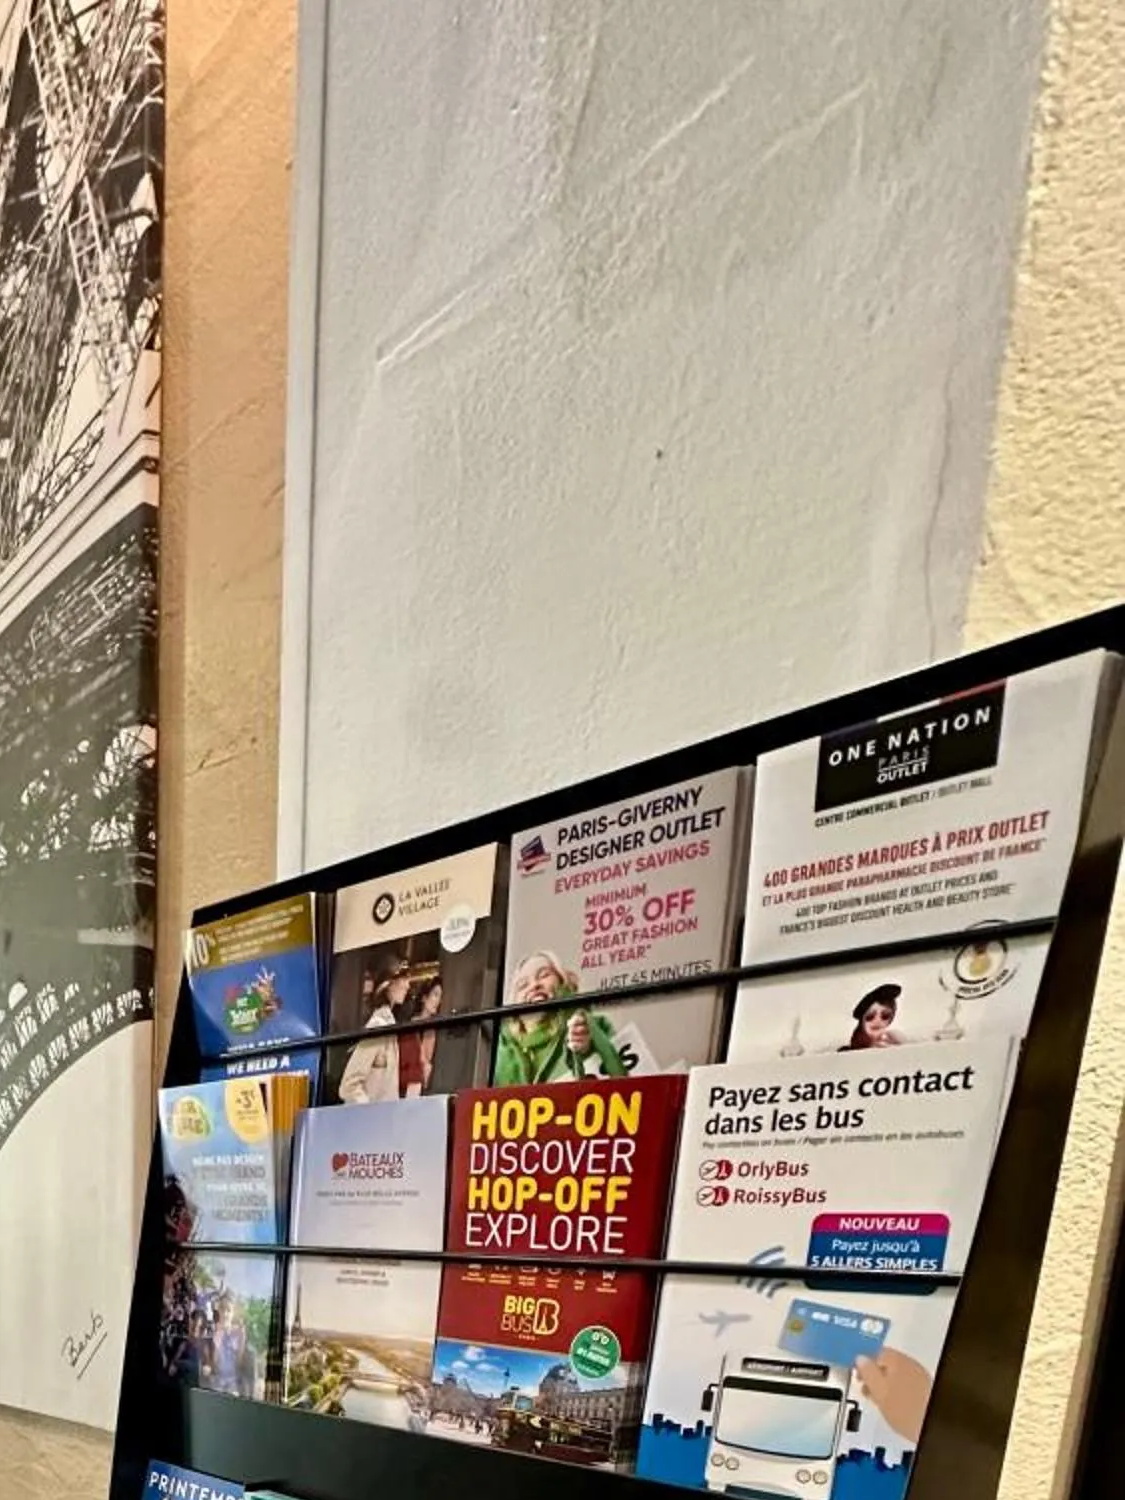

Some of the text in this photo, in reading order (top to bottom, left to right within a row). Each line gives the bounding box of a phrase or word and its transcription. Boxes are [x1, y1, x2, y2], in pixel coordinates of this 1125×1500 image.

[829, 706, 991, 766] ONE NATION
[878, 745, 930, 767] PARIS
[877, 762, 927, 784] OUTLET
[557, 786, 703, 846] PARIS-GIVERNY
[556, 807, 725, 871] DESIGNER OUTLET
[763, 810, 1050, 887] 400 GRANDES MARQUES À PRIX OUTLET
[554, 840, 710, 894] EVERYDAY SAVINGS
[399, 896, 440, 916] VILLAGE
[585, 883, 647, 909] MINIMUM
[774, 893, 783, 904] LA
[584, 889, 696, 935] 30% OFF
[582, 917, 698, 952] GREAT FASHION
[581, 952, 605, 970] ALL
[631, 970, 648, 986] 45
[650, 959, 712, 984] MINUTES
[708, 1065, 975, 1111] Payez sans contact
[472, 1091, 642, 1140] HOP-ON
[705, 1106, 864, 1136] dans les bus
[349, 1152, 404, 1166] BATEAUX
[469, 1139, 635, 1175] DISCOVER
[349, 1166, 404, 1180] MOUCHES
[738, 1161, 810, 1181] OrlyBus
[467, 1175, 632, 1214] HOP-OFF
[733, 1188, 827, 1207] RoissyBus
[465, 1213, 628, 1254] EXPLORE
[839, 1217, 920, 1231] NOUVEAU
[832, 1238, 869, 1253] Payez
[811, 1255, 938, 1271] 5 ALLERS SIMPLES
[504, 1295, 536, 1315] BIG
[500, 1313, 533, 1334] BUS
